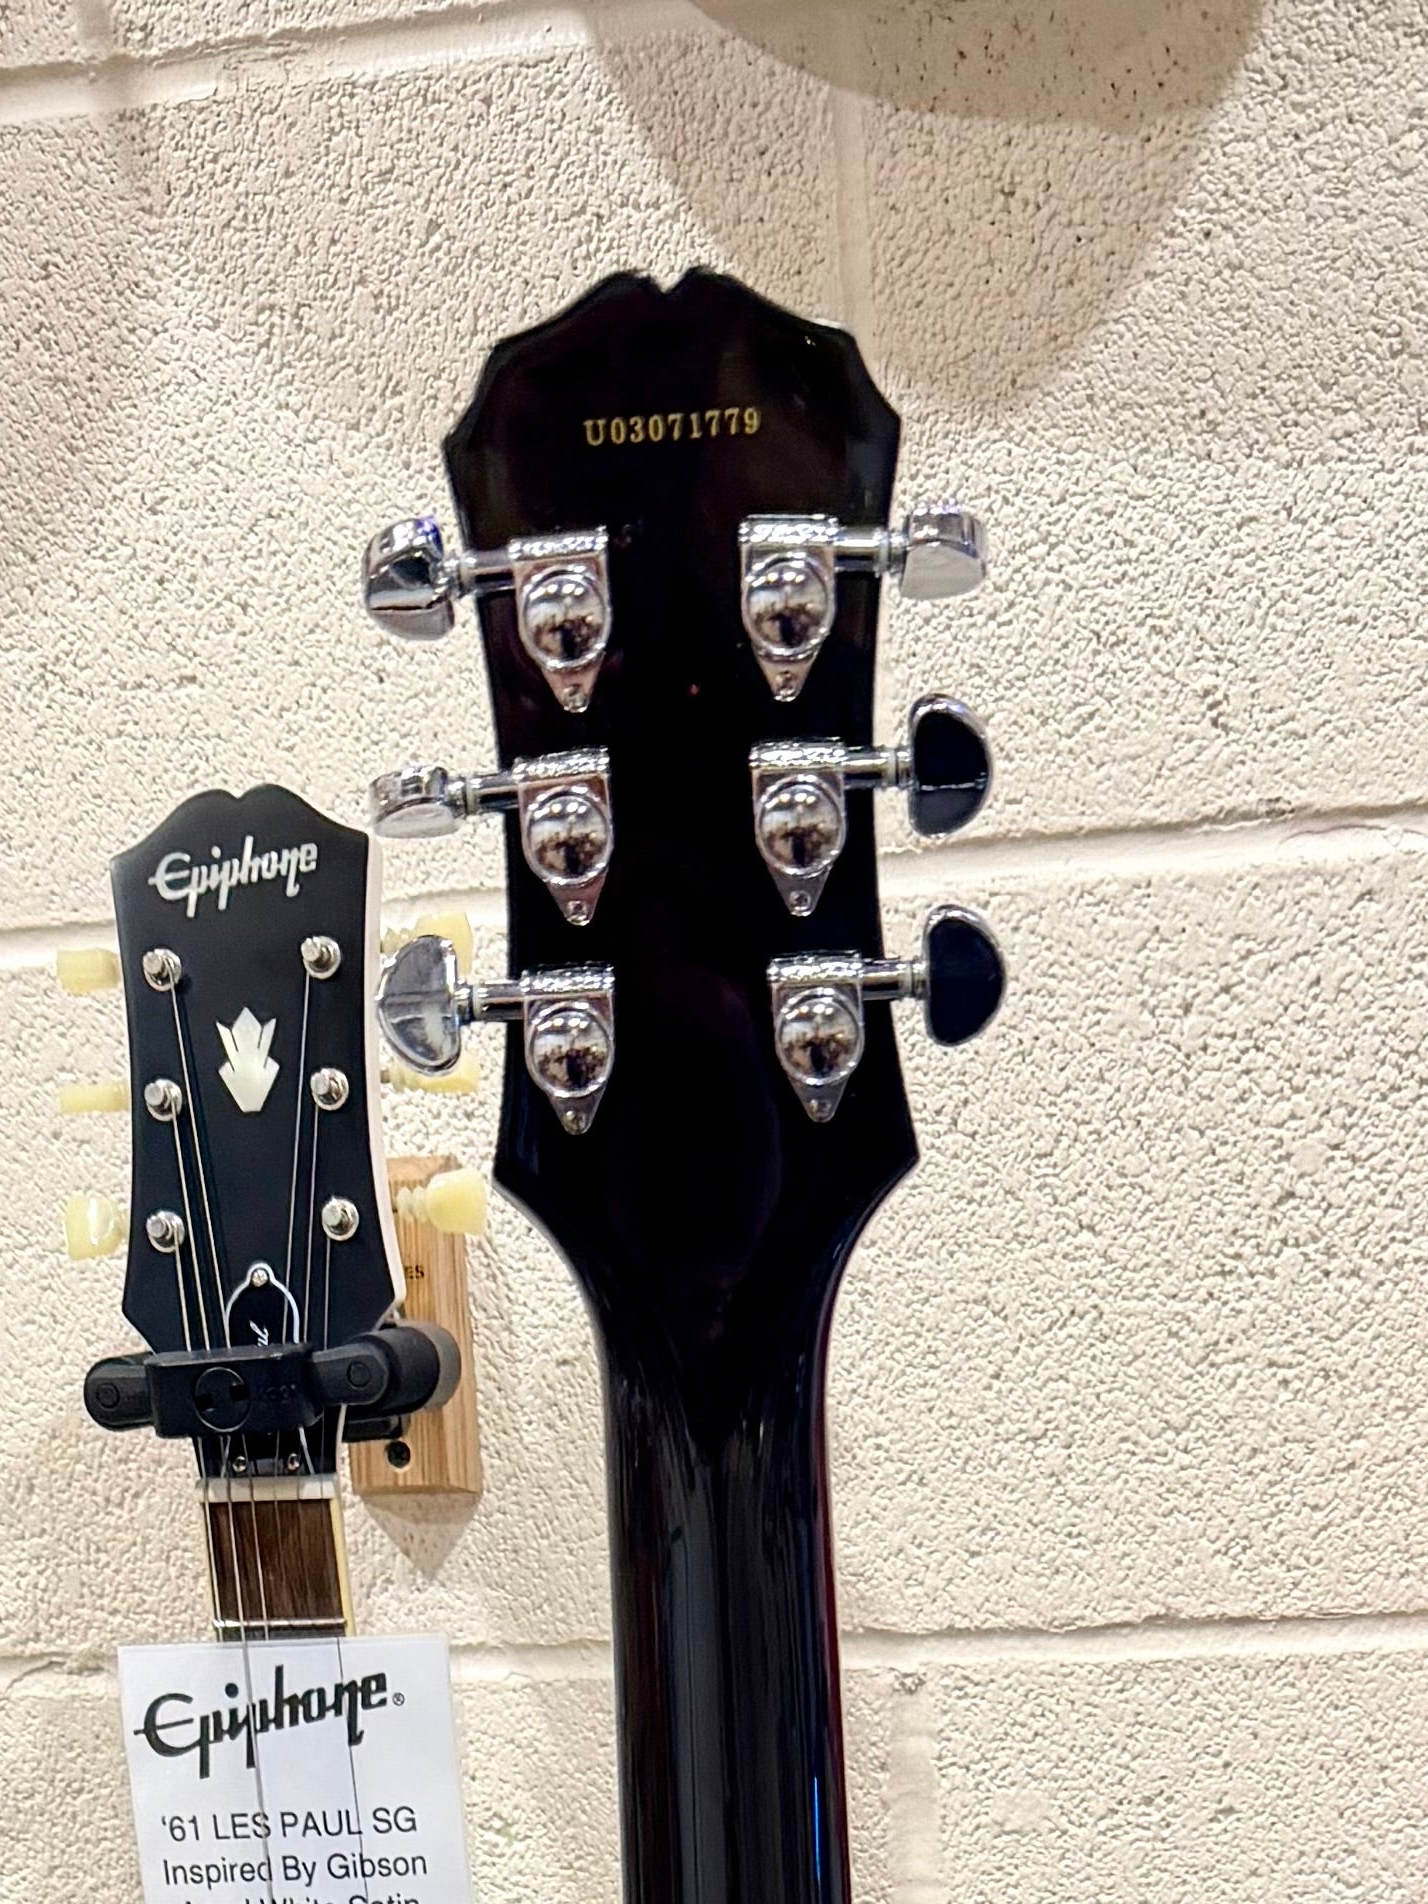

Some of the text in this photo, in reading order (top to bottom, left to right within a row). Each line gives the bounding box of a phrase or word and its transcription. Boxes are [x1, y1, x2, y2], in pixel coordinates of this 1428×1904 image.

[582, 405, 762, 447] U03071779
[147, 835, 318, 918] Epiphone
[214, 1813, 270, 1840] LES
[282, 1811, 361, 1838] PAUL
[372, 1807, 417, 1834] SG
[163, 1851, 427, 1892] Inspired By Gibson
